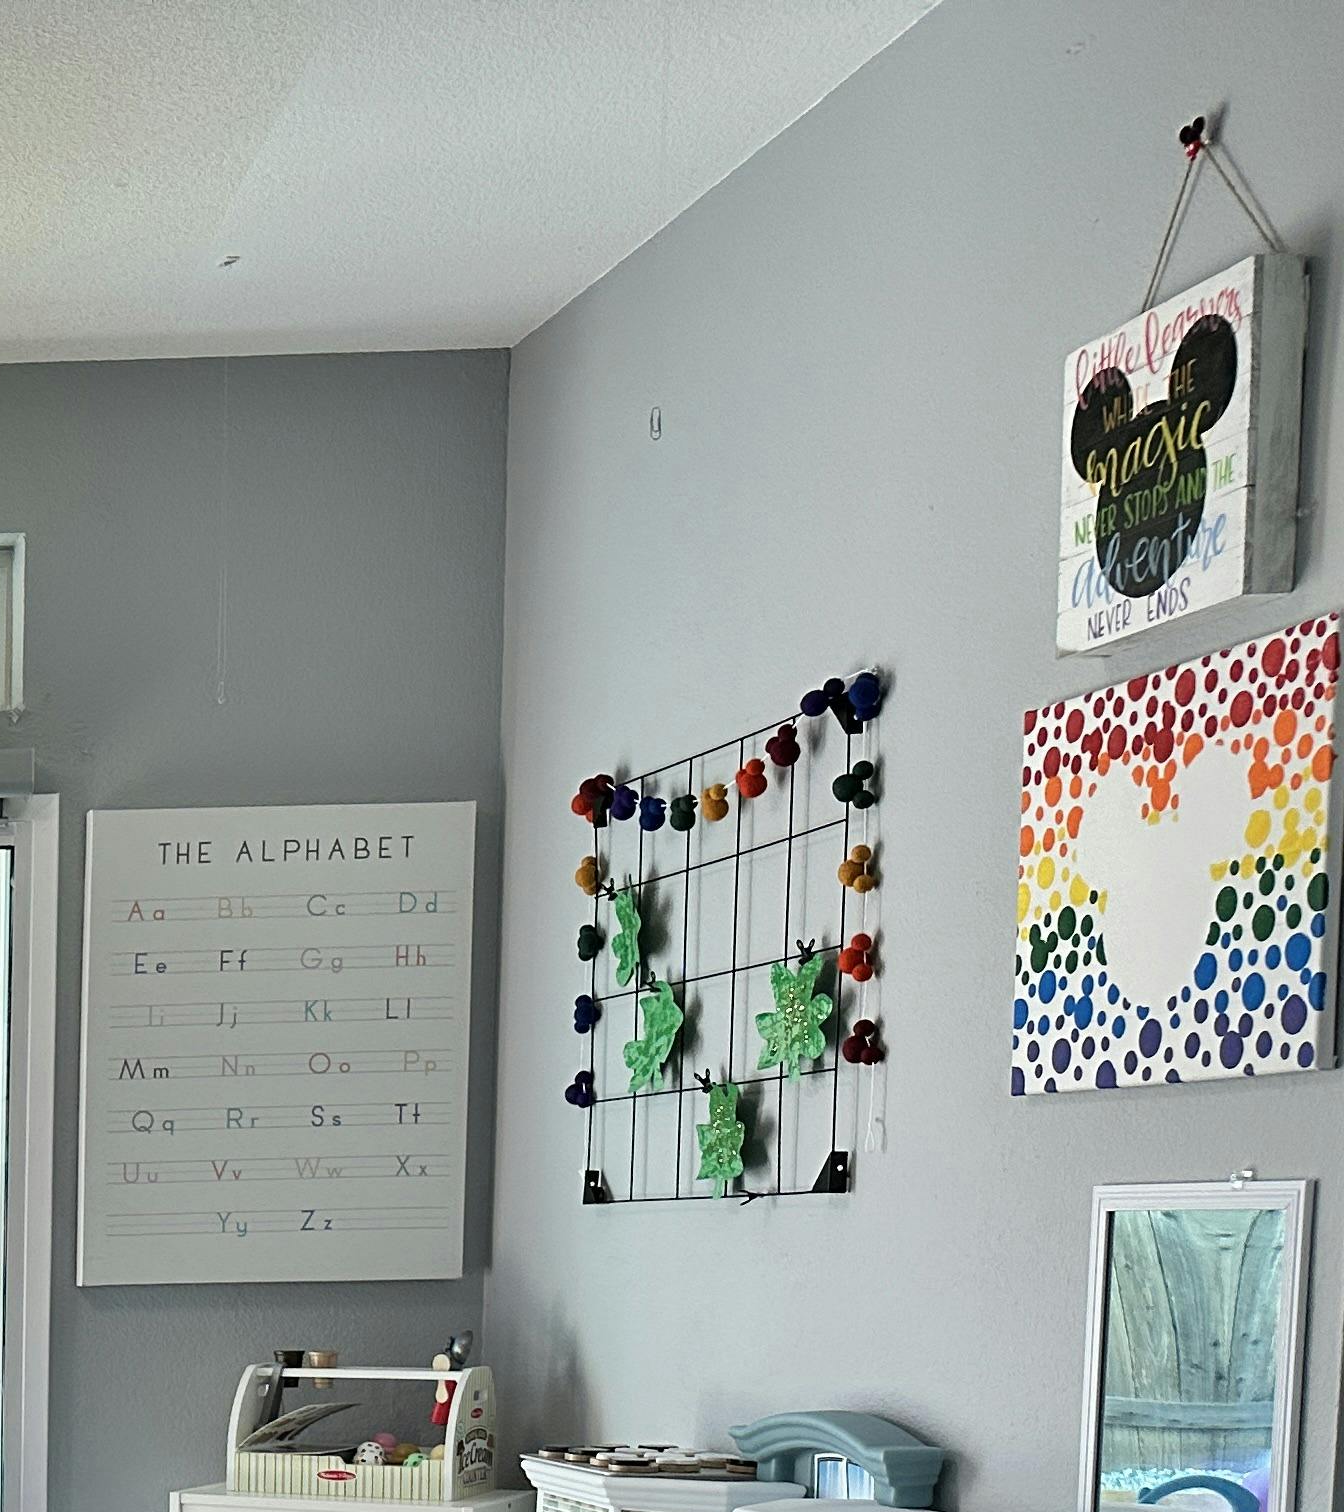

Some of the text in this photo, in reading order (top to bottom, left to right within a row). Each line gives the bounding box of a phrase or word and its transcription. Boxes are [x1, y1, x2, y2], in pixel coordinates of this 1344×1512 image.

[1166, 357, 1197, 406] THE
[1086, 399, 1212, 497] magic
[1073, 451, 1236, 547] NEVER STOPS AND THE
[1072, 511, 1228, 609] adventure
[1086, 577, 1190, 641] NEVER ENDS
[158, 834, 415, 866] THE ALPHABET
